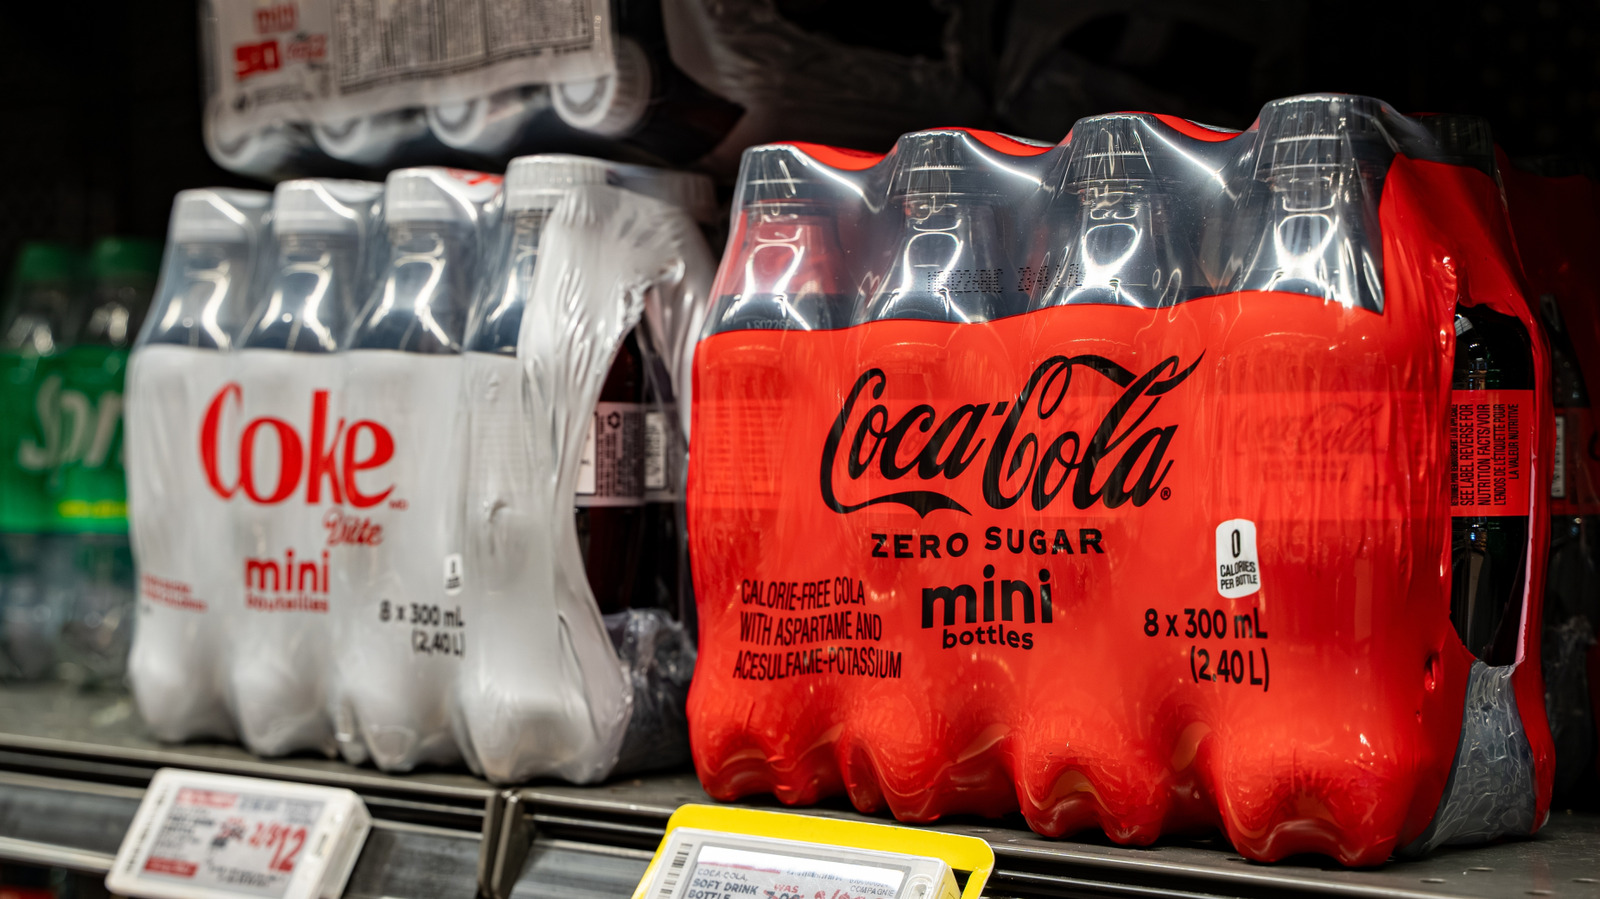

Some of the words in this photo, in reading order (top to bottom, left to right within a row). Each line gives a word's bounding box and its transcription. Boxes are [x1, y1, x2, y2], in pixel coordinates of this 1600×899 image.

[1459, 404, 1474, 421] FOR
[1493, 404, 1506, 423] POUR
[1507, 404, 1520, 440] NUTRITIVE
[820, 348, 1207, 519] Coca-Cola
[1459, 422, 1474, 461] REVERSE
[1477, 404, 1491, 456] FACTS/VOIR
[197, 381, 397, 510] Coke
[1508, 441, 1520, 469] VALEUR
[1459, 462, 1474, 489] LABEL
[1477, 458, 1491, 506] NUTRITION
[1493, 466, 1506, 477] DE
[1508, 470, 1520, 480] LA
[1459, 490, 1475, 506] SEE
[870, 531, 970, 560] ZERO
[984, 525, 1106, 556] SUGAR
[1231, 529, 1242, 559] 0
[243, 547, 331, 595] mini
[1219, 561, 1257, 578] CALORIES
[1219, 578, 1236, 591] PER
[1234, 574, 1259, 587] BOTTLE
[741, 579, 831, 611] CALORIE-FREE
[833, 576, 867, 606] COLA
[921, 564, 1054, 629] mini
[379, 600, 392, 623] 8
[396, 605, 406, 622] x
[410, 602, 442, 628] 300
[443, 605, 467, 629] mL
[740, 611, 773, 646] WITH
[774, 611, 853, 646] ASPARTAME
[855, 611, 883, 641] AND
[1143, 608, 1160, 637] 8
[1165, 614, 1180, 637] x
[1184, 608, 1228, 639] 300
[1233, 607, 1269, 639] mL
[942, 624, 1035, 650] bottles
[732, 646, 903, 681] ACESULFAME-POTASSIUM
[1190, 645, 1245, 684] (2.40
[691, 878, 724, 892] SOFT
[723, 882, 760, 897] DRINK
[773, 883, 800, 895] WAS
[849, 885, 896, 898] COMPAGNIE
